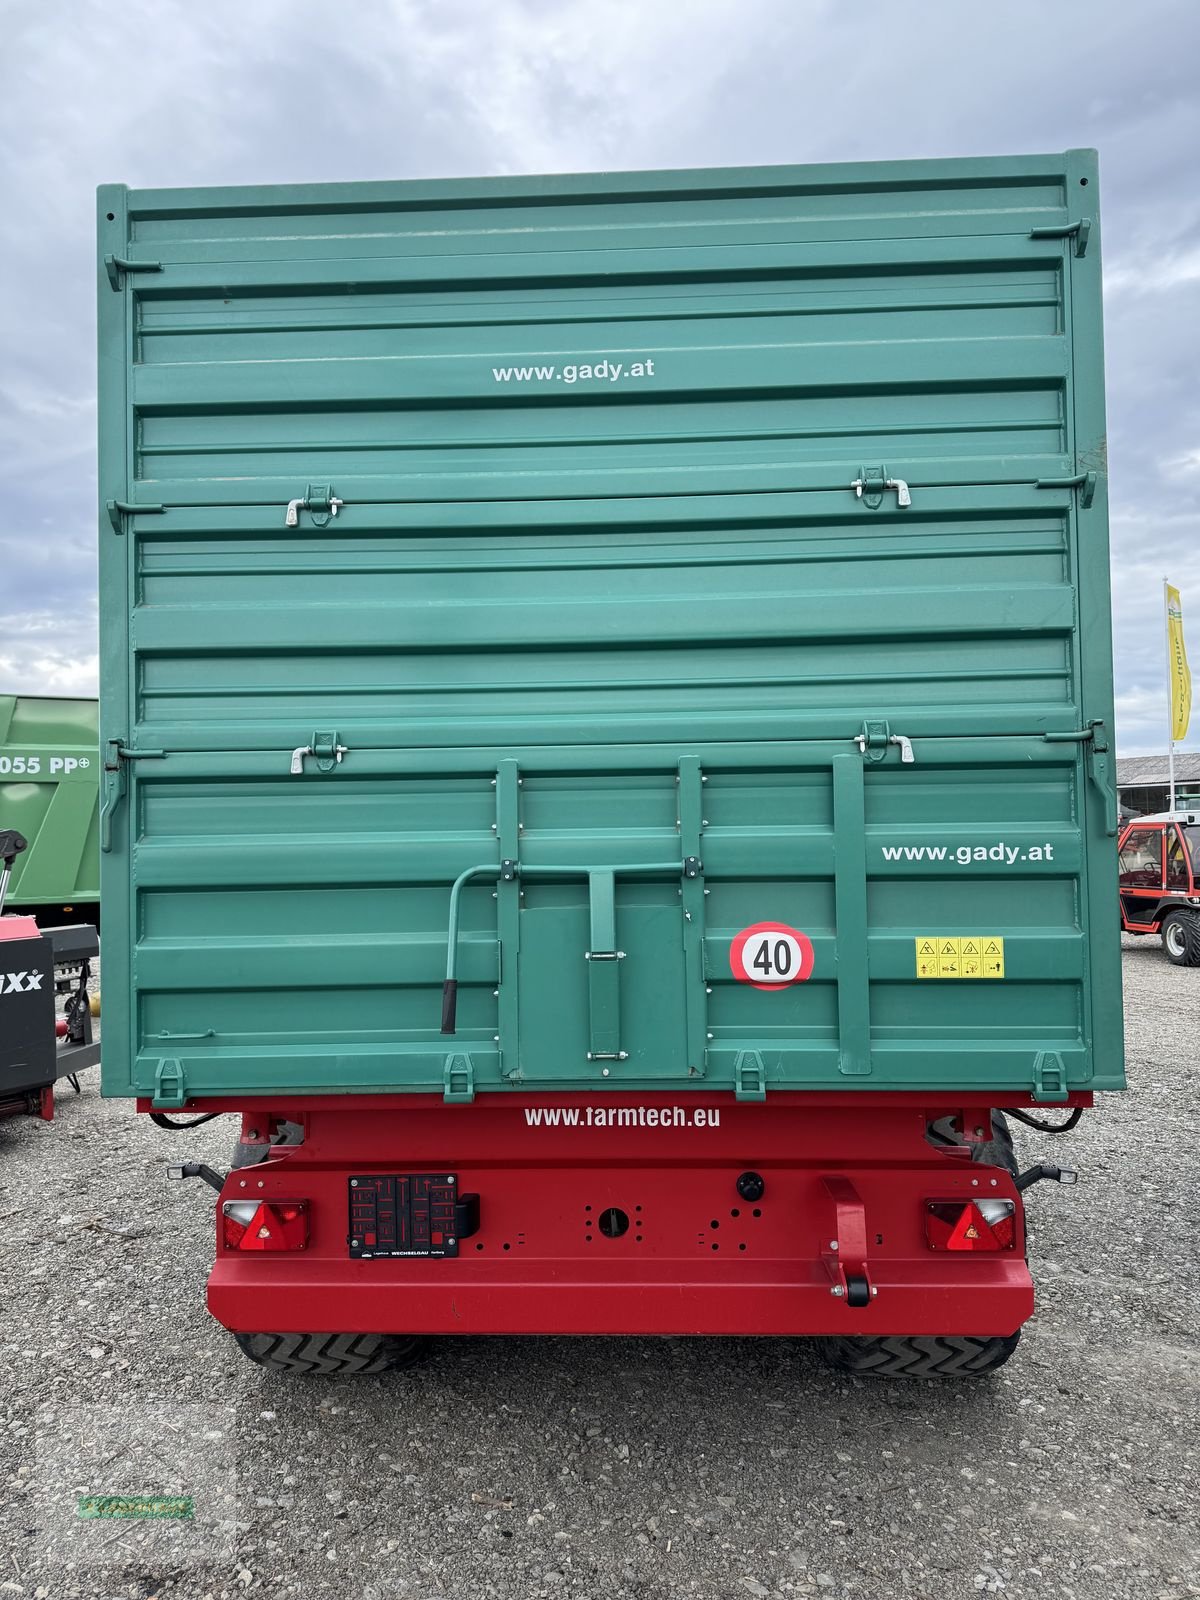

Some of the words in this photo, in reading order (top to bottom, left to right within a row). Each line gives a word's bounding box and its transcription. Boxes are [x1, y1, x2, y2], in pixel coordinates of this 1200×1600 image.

[492, 359, 655, 384] www.gady.at
[882, 843, 1054, 865] www.gady.at
[753, 939, 792, 976] 40
[524, 1106, 721, 1127] www.farmtech.eu
